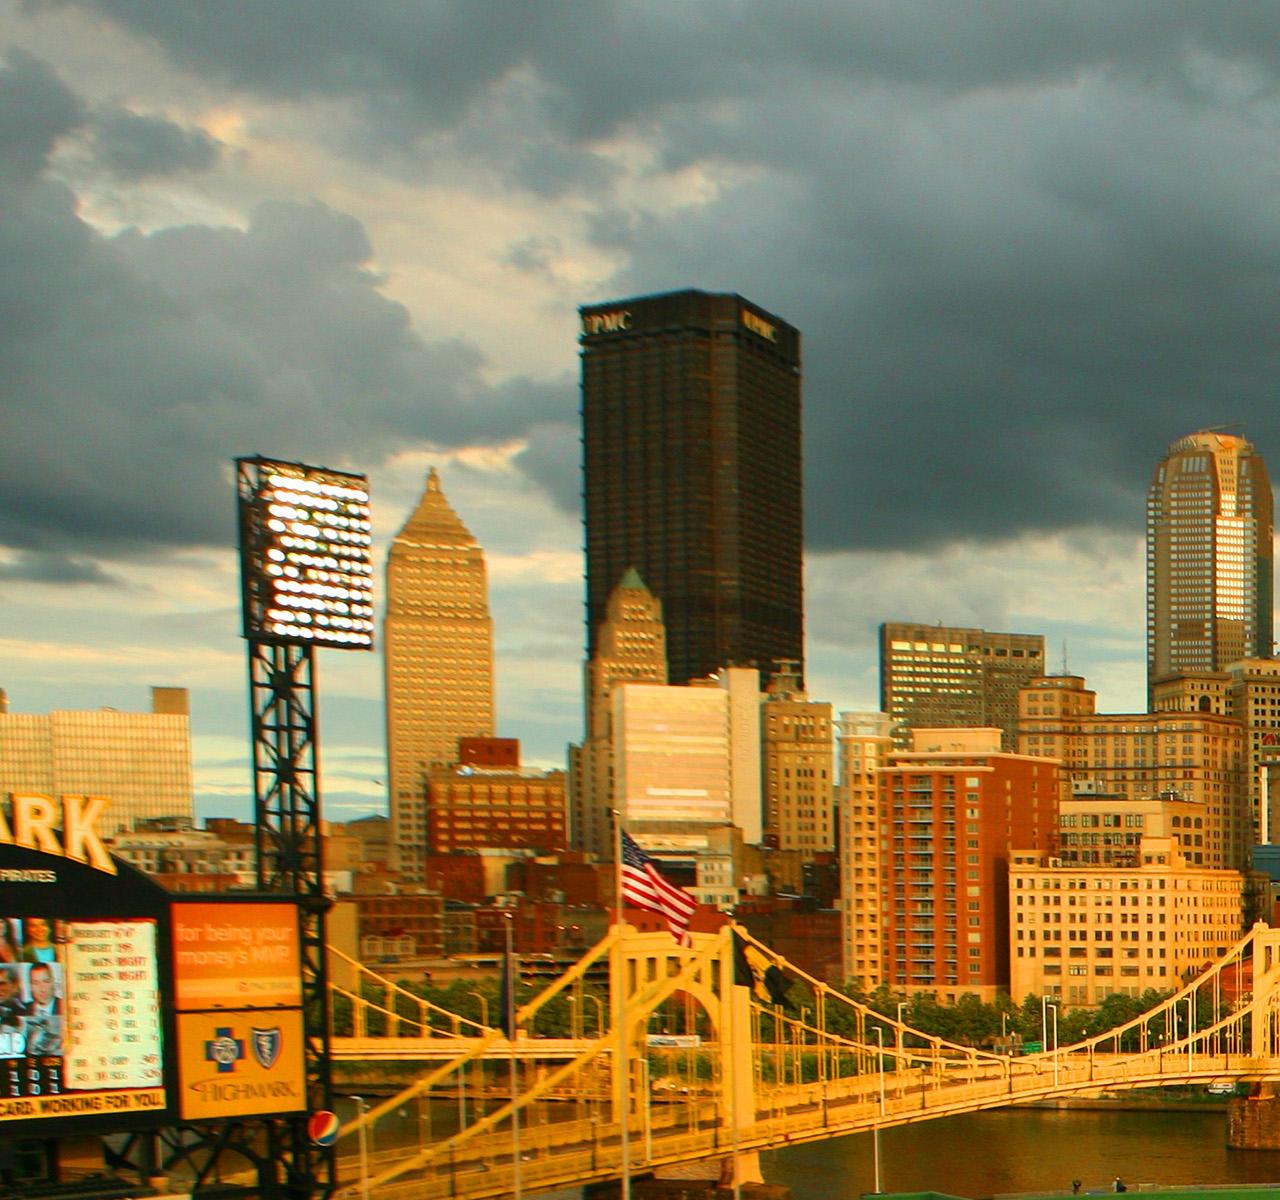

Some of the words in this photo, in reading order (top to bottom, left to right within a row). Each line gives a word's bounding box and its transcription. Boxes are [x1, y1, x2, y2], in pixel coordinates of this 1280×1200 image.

[0, 791, 118, 876] RK
[176, 923, 203, 942] for
[206, 923, 251, 946] being
[254, 926, 293, 946] your
[177, 946, 249, 969] money's
[200, 1081, 298, 1102] HIGHMARK
[40, 1097, 102, 1113] WORKING
[105, 1095, 132, 1109] FOR
